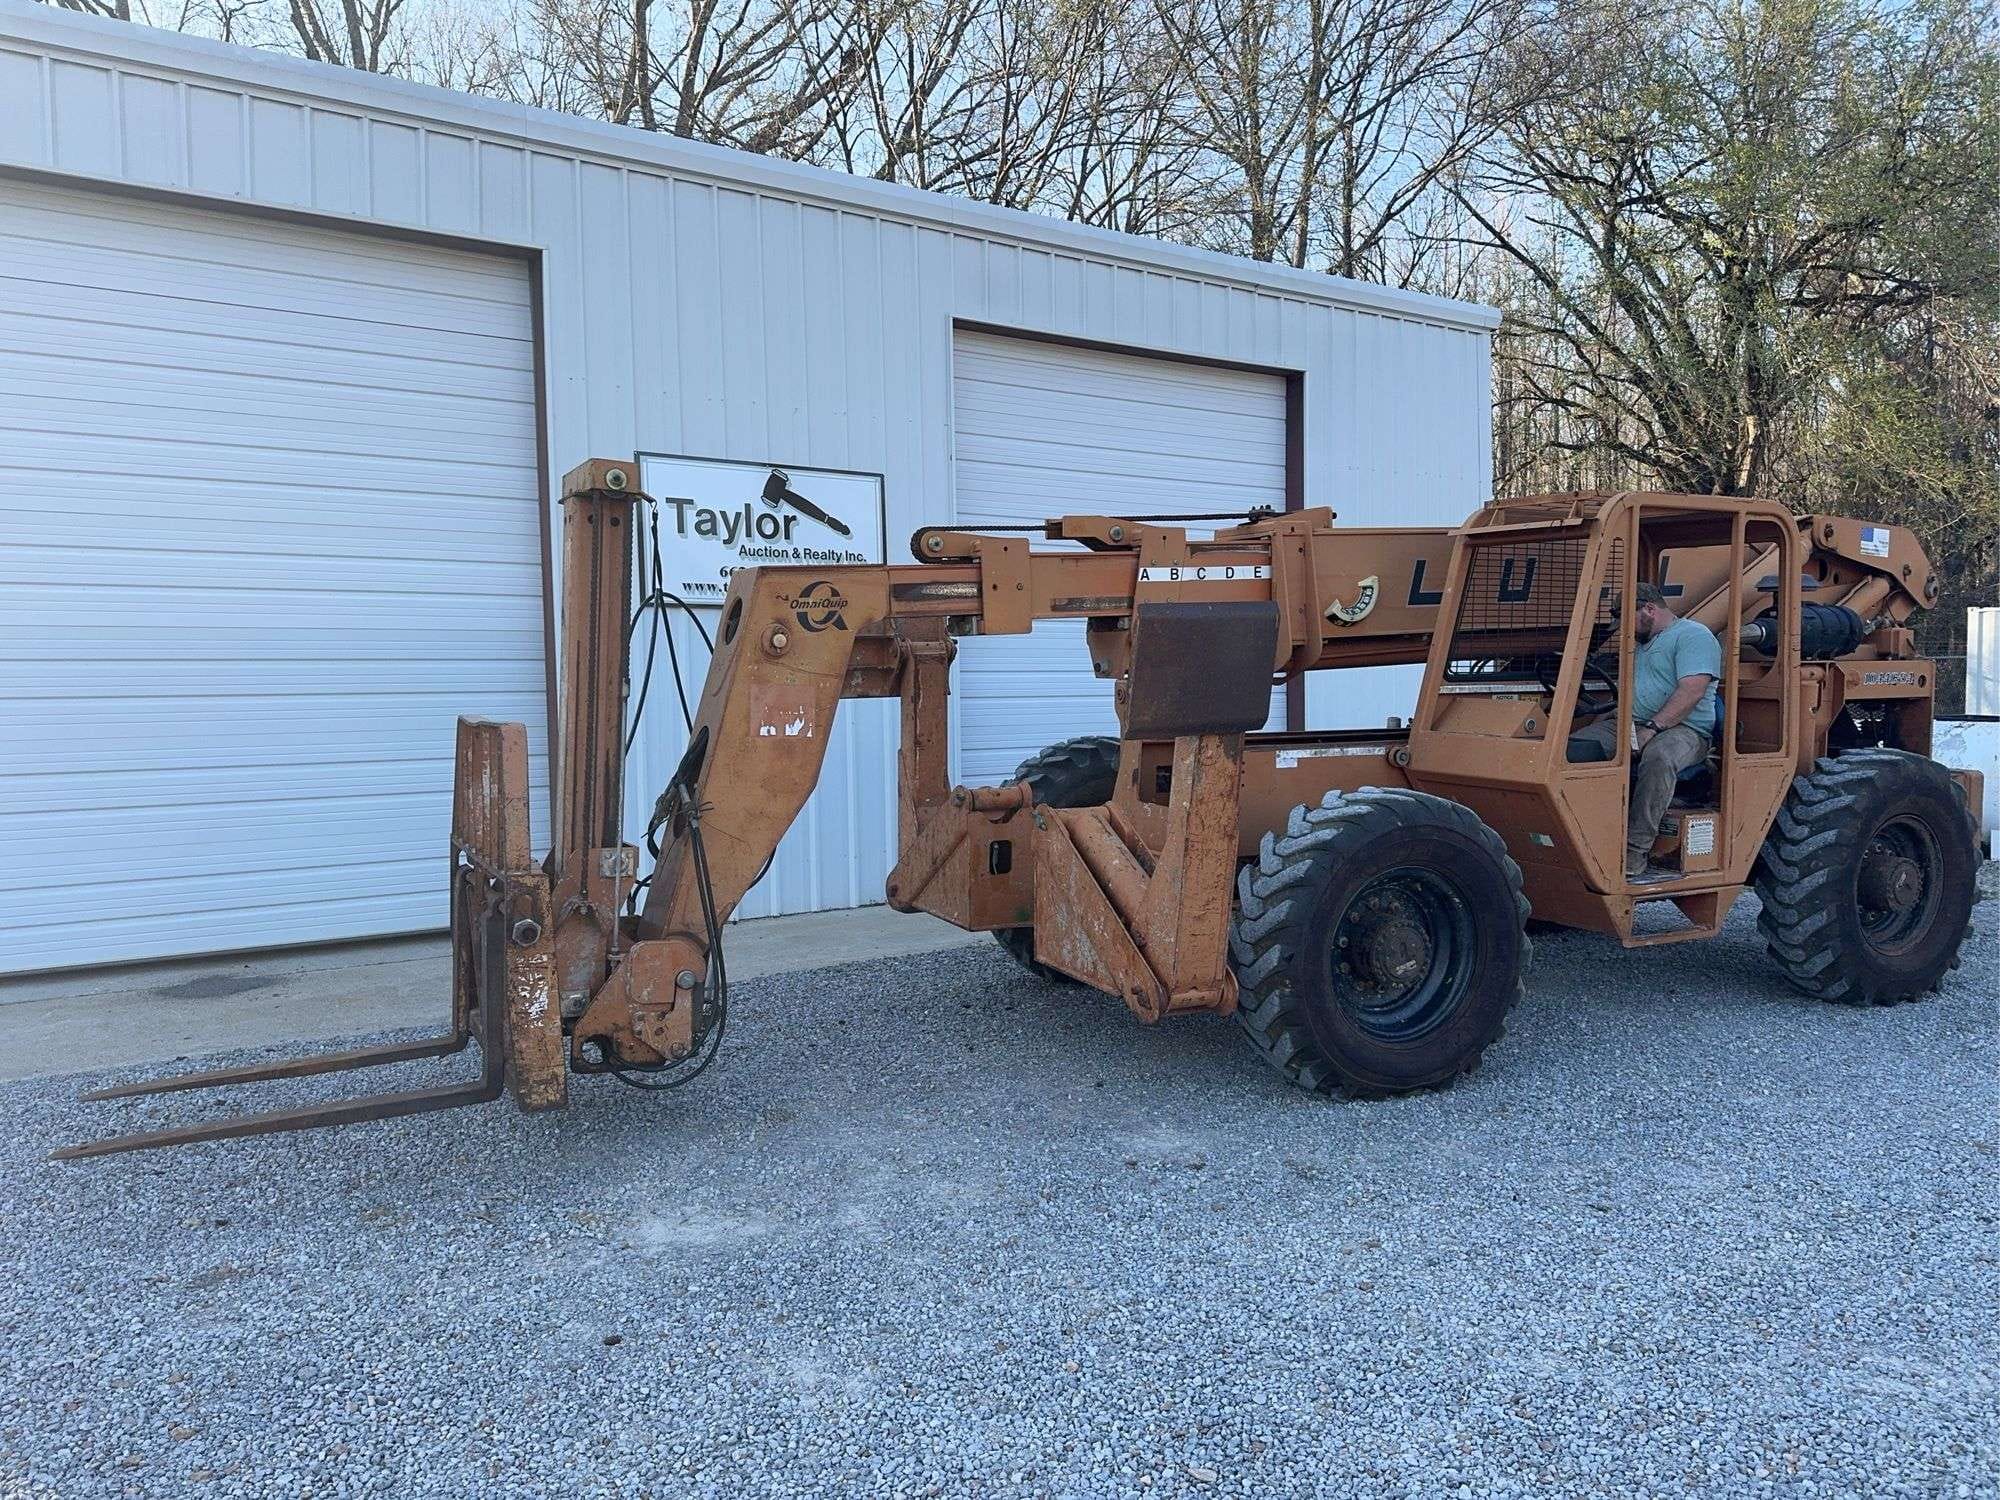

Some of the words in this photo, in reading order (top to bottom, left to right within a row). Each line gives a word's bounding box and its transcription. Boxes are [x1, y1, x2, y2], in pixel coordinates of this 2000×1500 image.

[665, 497, 798, 545] Taylor
[738, 544, 789, 559] Auction
[791, 547, 801, 559] &
[803, 548, 843, 563] Realty
[845, 550, 867, 562] Inc.
[1140, 568, 1150, 580] A
[1170, 568, 1179, 580] B
[1196, 567, 1207, 580] C
[1225, 567, 1235, 579] D
[1253, 566, 1262, 578] E
[790, 598, 848, 610] OmniQuip
